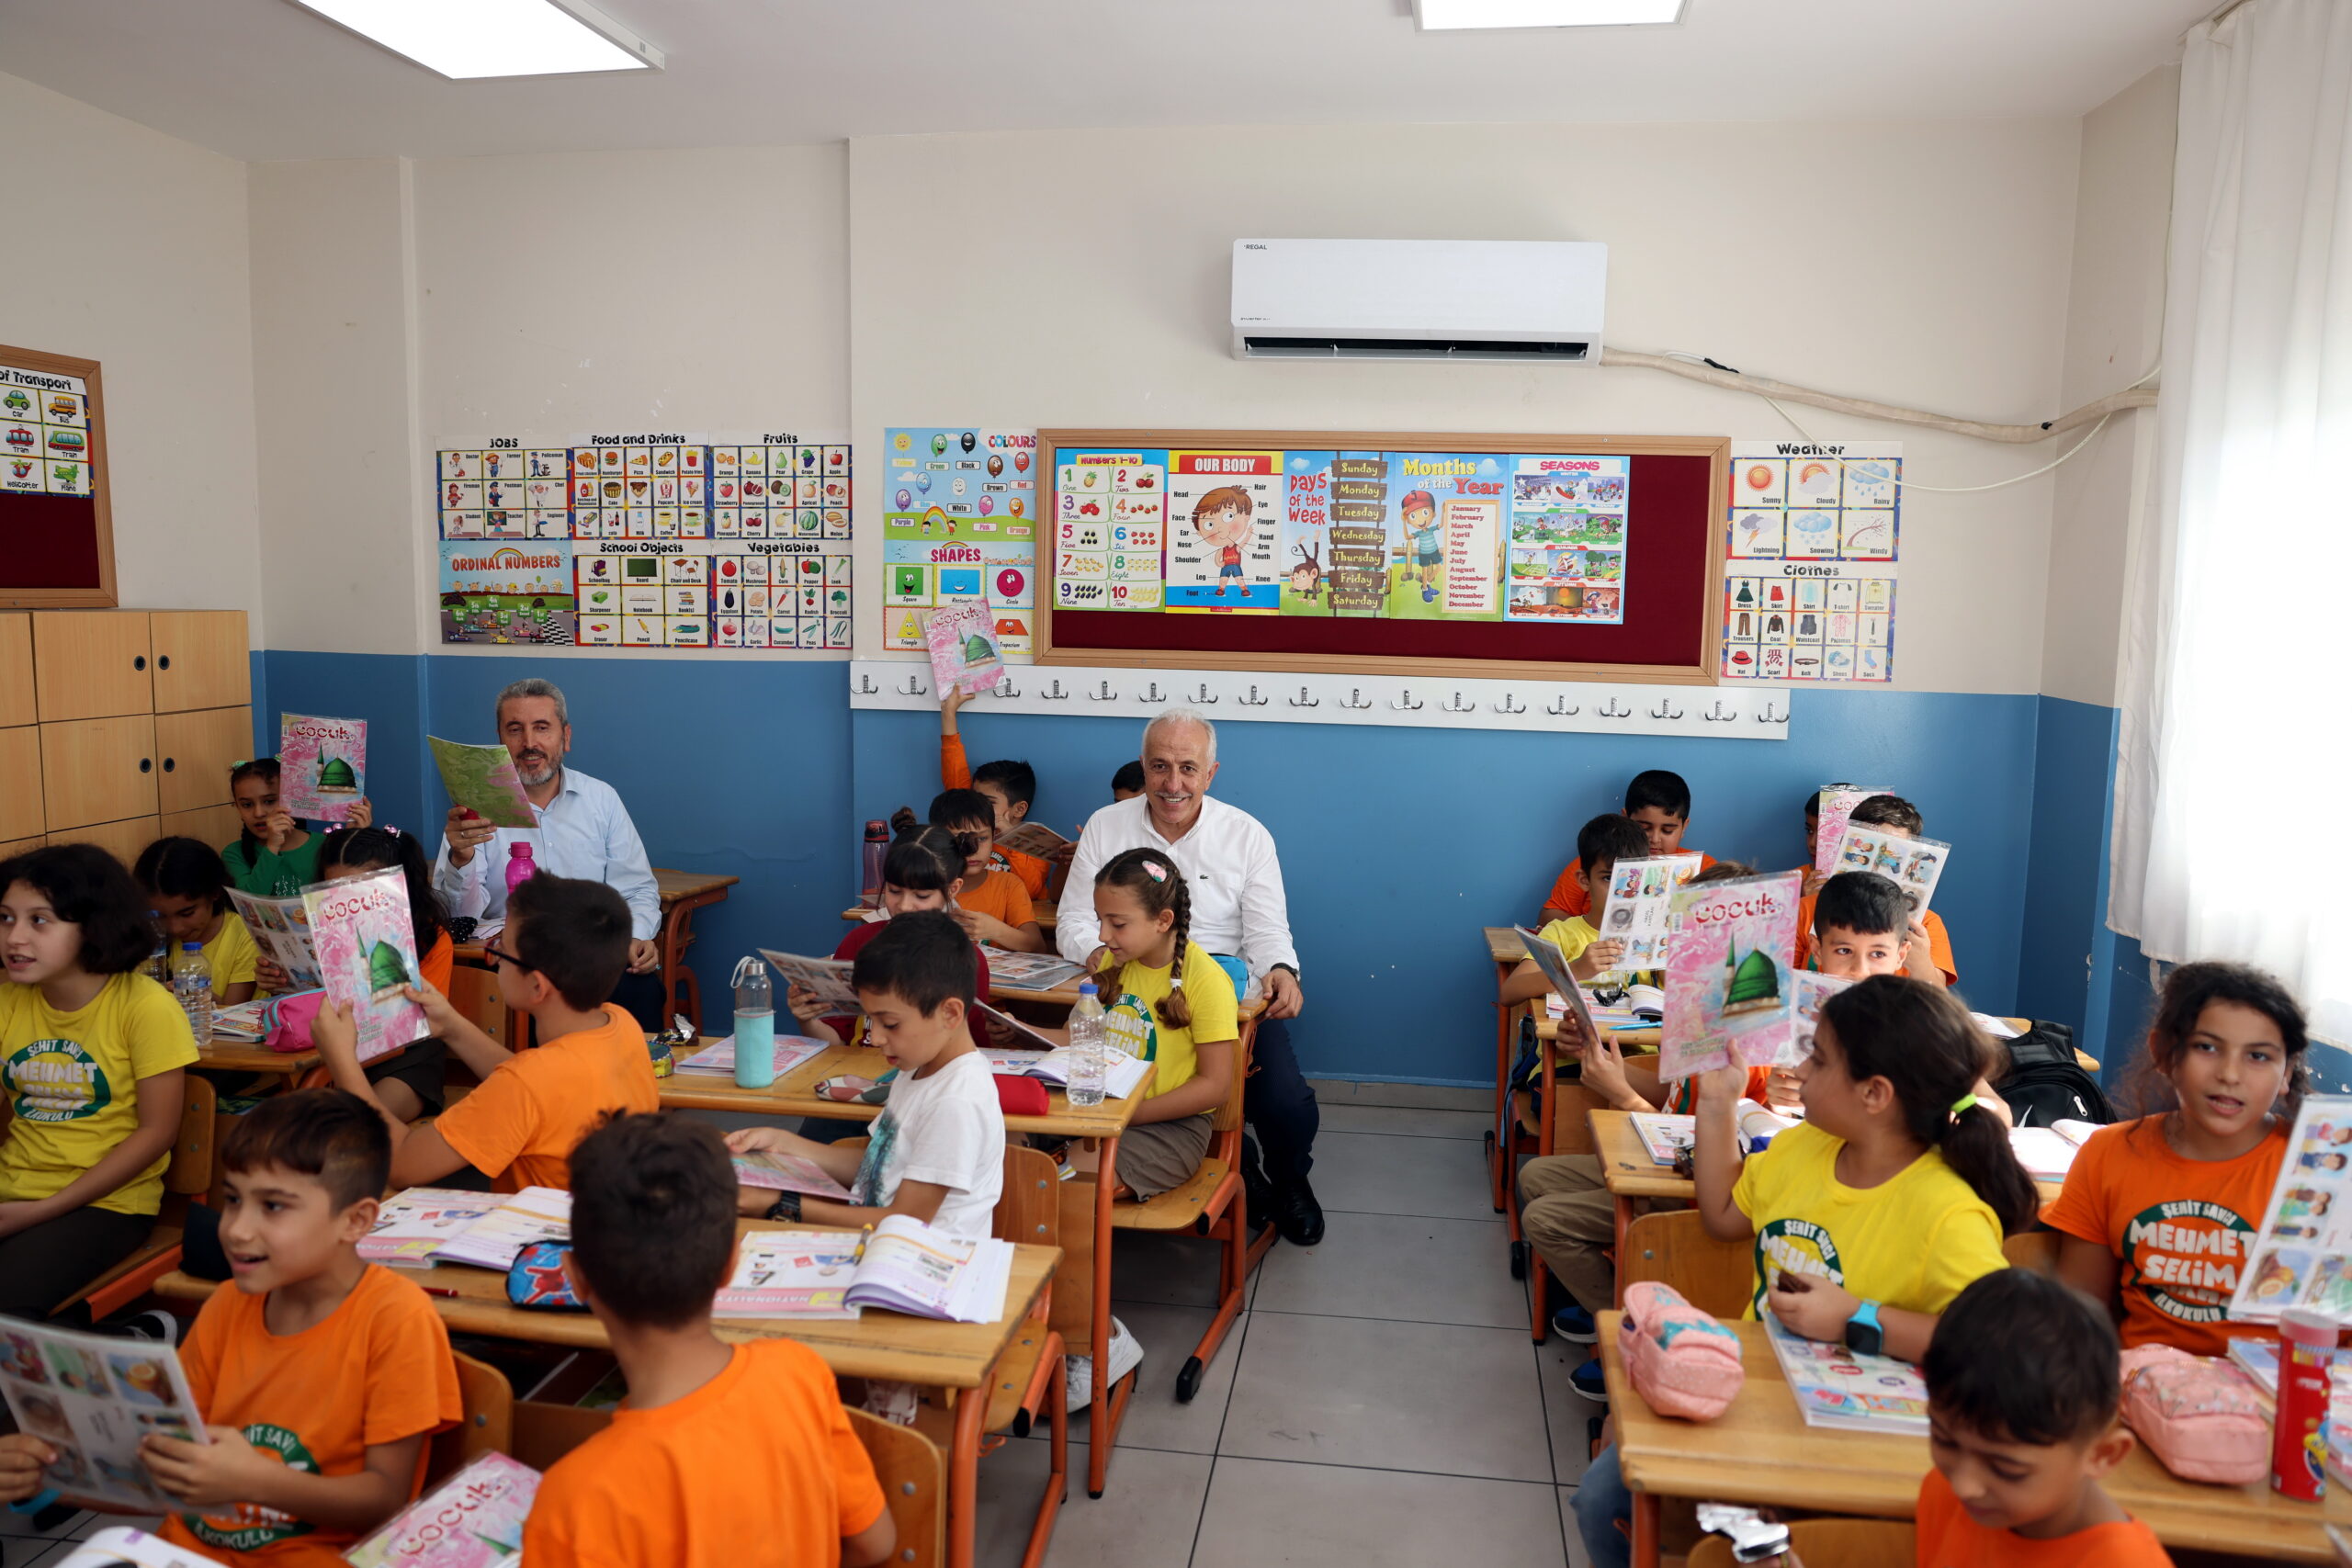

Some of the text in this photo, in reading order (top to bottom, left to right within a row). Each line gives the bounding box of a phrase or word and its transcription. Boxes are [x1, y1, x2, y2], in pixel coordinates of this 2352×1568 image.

[13, 372, 72, 390] Transport
[490, 438, 518, 448] JOBS
[592, 434, 685, 445] Food and Drinks
[763, 433, 797, 444] Fruits
[989, 434, 1036, 448] COLOURS
[1195, 458, 1255, 472] OUR BODY
[1341, 463, 1378, 476] Sunday
[1403, 458, 1476, 476] Months
[1540, 461, 1600, 470] SEASONS
[1065, 468, 1071, 482] 1
[1117, 469, 1125, 482] 2
[1291, 473, 1327, 492] Days
[1418, 478, 1504, 494] of the Year
[1339, 485, 1380, 498] Monday
[1063, 495, 1074, 510] 3
[1116, 499, 1126, 513] 4
[1289, 494, 1324, 506] of the
[1288, 507, 1326, 525] Week
[1338, 506, 1379, 519] Tuesday
[1062, 525, 1073, 538] 5
[1114, 527, 1126, 540] 6
[1332, 530, 1384, 542] Wednesday
[600, 543, 683, 555] School Objects
[748, 543, 820, 554] Vegetables
[931, 548, 980, 562] SHAPES
[452, 556, 560, 571] ORDINAL NUMBERS
[1062, 555, 1072, 567] 7
[1114, 556, 1125, 569] 8
[1334, 551, 1381, 565] Thursday
[1784, 565, 1839, 576] Clothes
[1340, 573, 1372, 586] Friday
[1061, 583, 1071, 597] 9
[1112, 586, 1127, 598] 10
[1334, 594, 1378, 608] Saturday
[8, 1060, 98, 1083] MEHMET
[2129, 1219, 2259, 1259] MEHMET
[2144, 1254, 2236, 1290] SELİM
